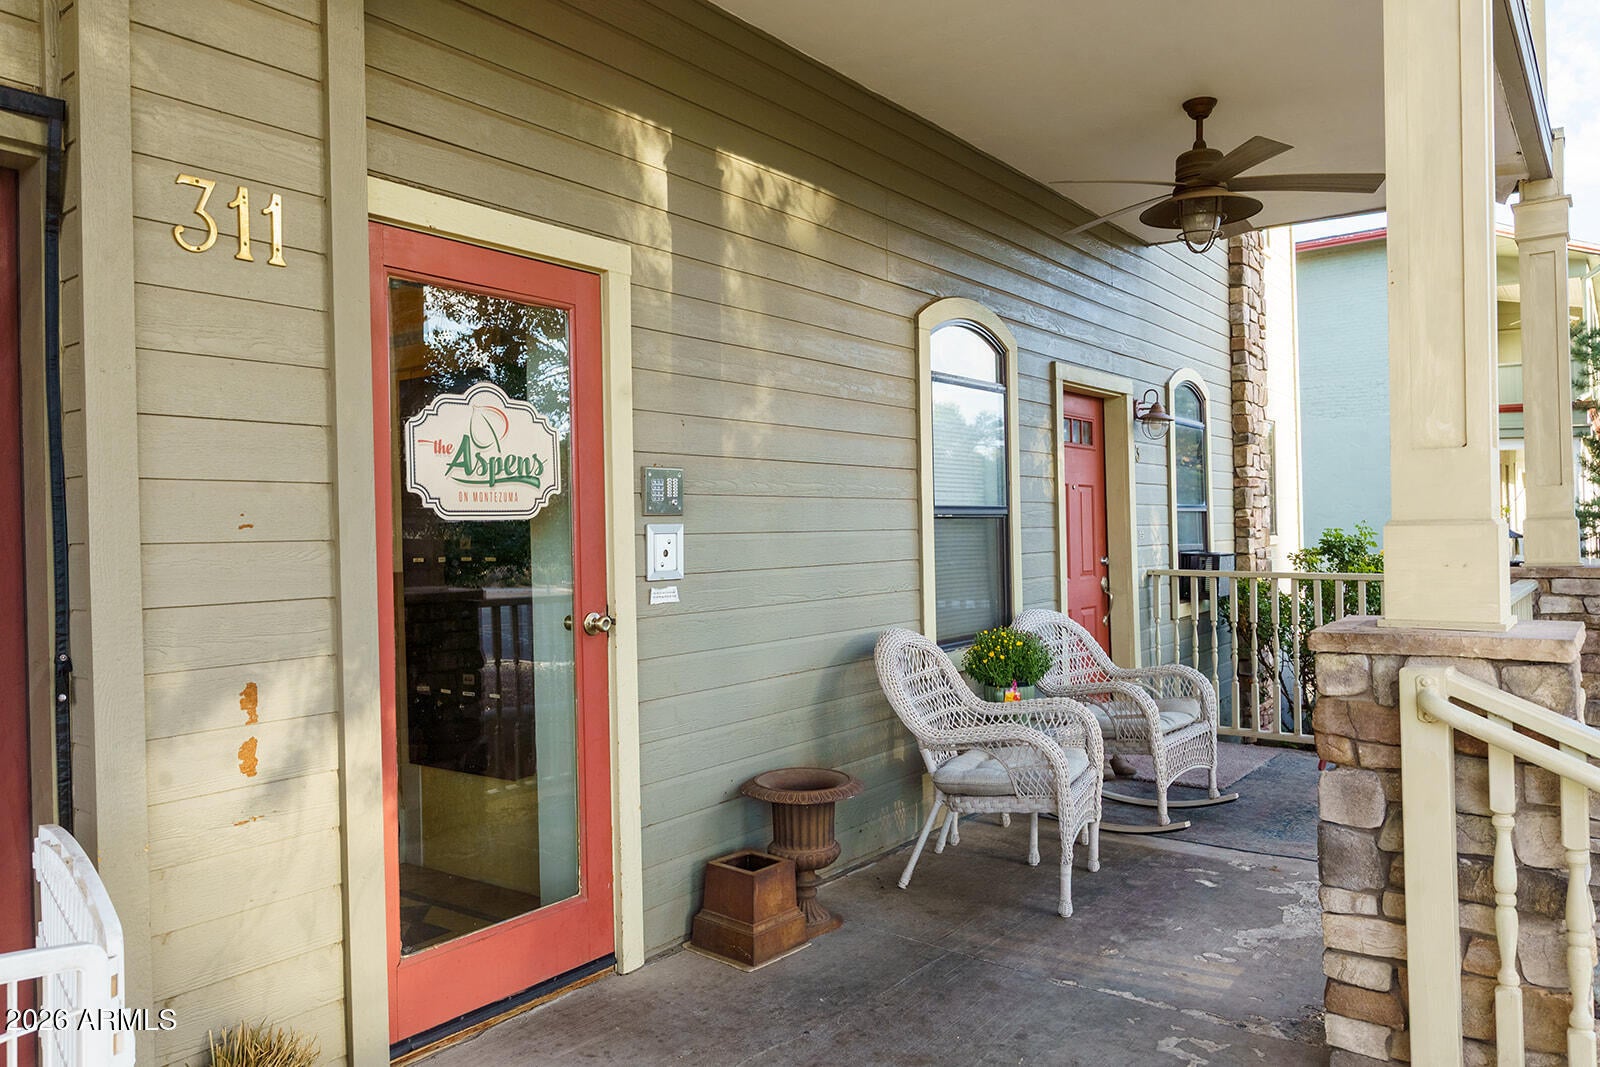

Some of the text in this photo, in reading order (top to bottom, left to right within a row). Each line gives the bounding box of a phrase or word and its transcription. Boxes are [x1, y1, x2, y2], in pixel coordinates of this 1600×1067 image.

[173, 173, 287, 267] 311
[425, 434, 547, 488] the Aspens
[458, 491, 519, 503] ON MONTEZUMA
